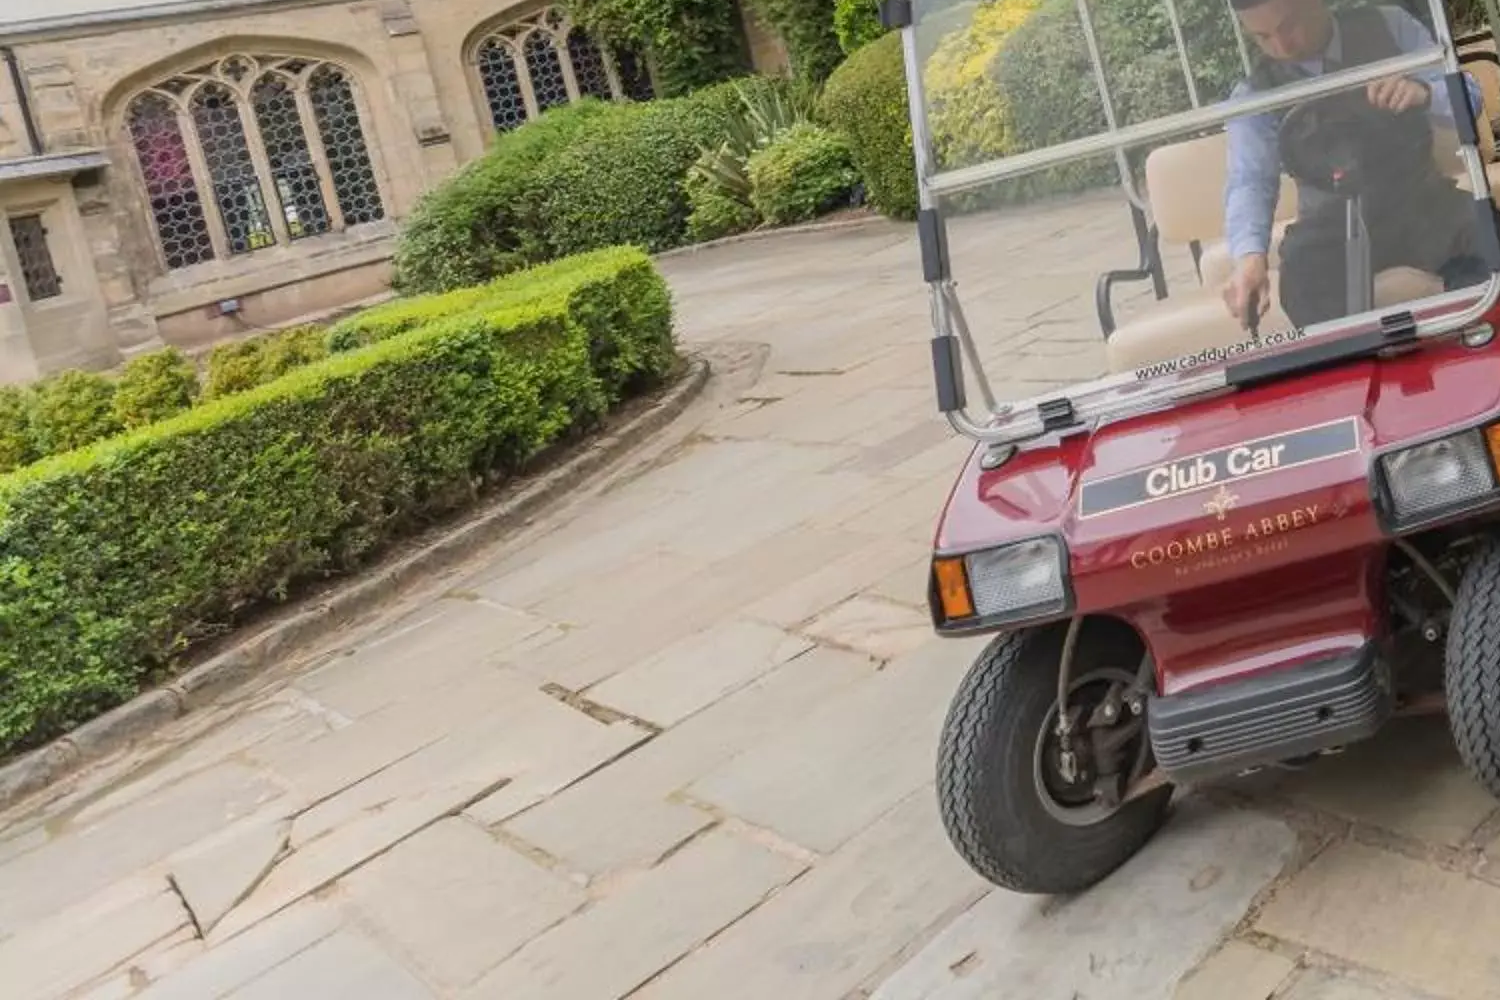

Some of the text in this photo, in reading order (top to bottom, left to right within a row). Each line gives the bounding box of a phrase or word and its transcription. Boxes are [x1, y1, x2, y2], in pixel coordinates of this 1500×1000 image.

[1145, 444, 1285, 496] Club Car
[1131, 527, 1233, 569] COOMBE
[1246, 503, 1319, 540] ABBEY
